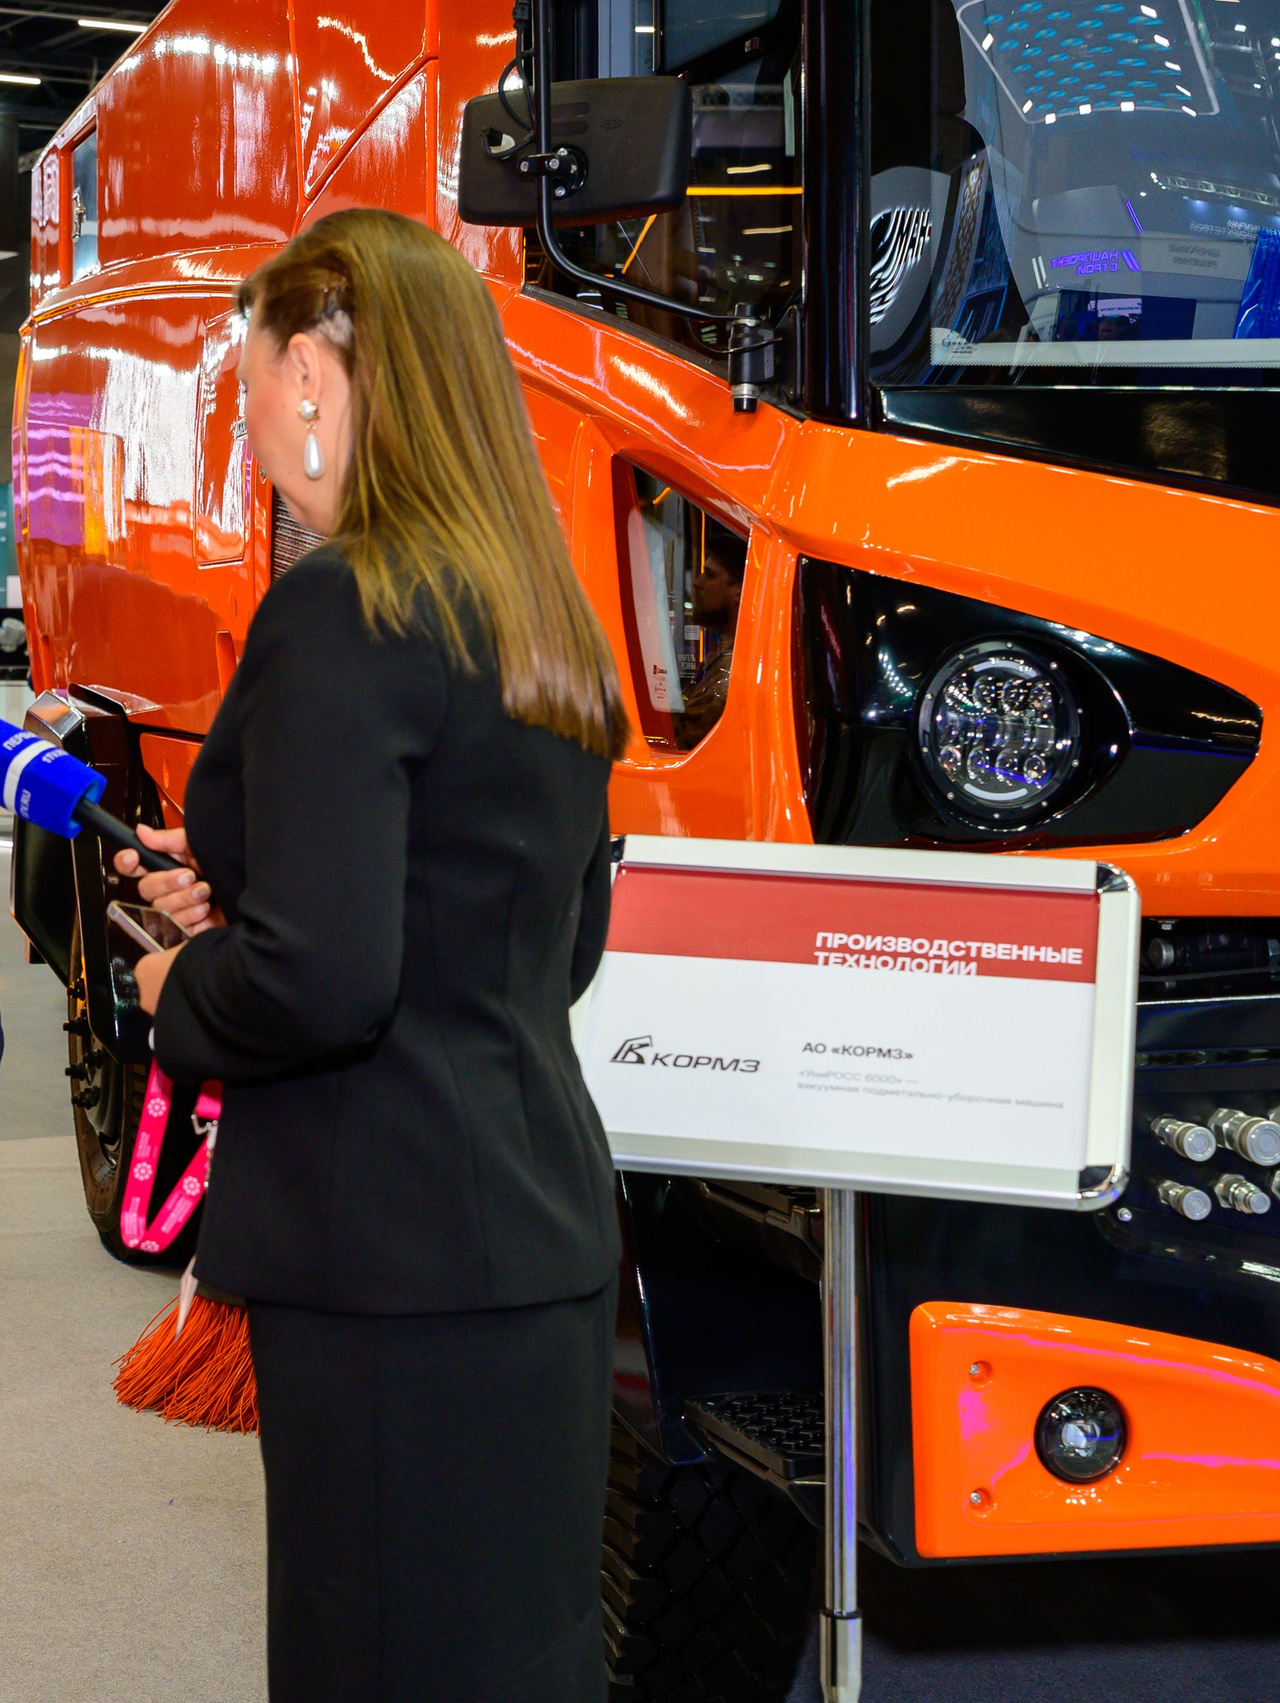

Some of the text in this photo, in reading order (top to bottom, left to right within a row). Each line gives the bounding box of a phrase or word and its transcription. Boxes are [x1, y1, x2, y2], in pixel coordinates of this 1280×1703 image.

[815, 932, 1083, 965] ПРОИЗВОДСТВЕННЫЕ
[813, 951, 978, 977] ТЕХНОЛОГИИ
[802, 1042, 914, 1060] АО «КОРМЗ»
[651, 1053, 761, 1073] КОРМЗ
